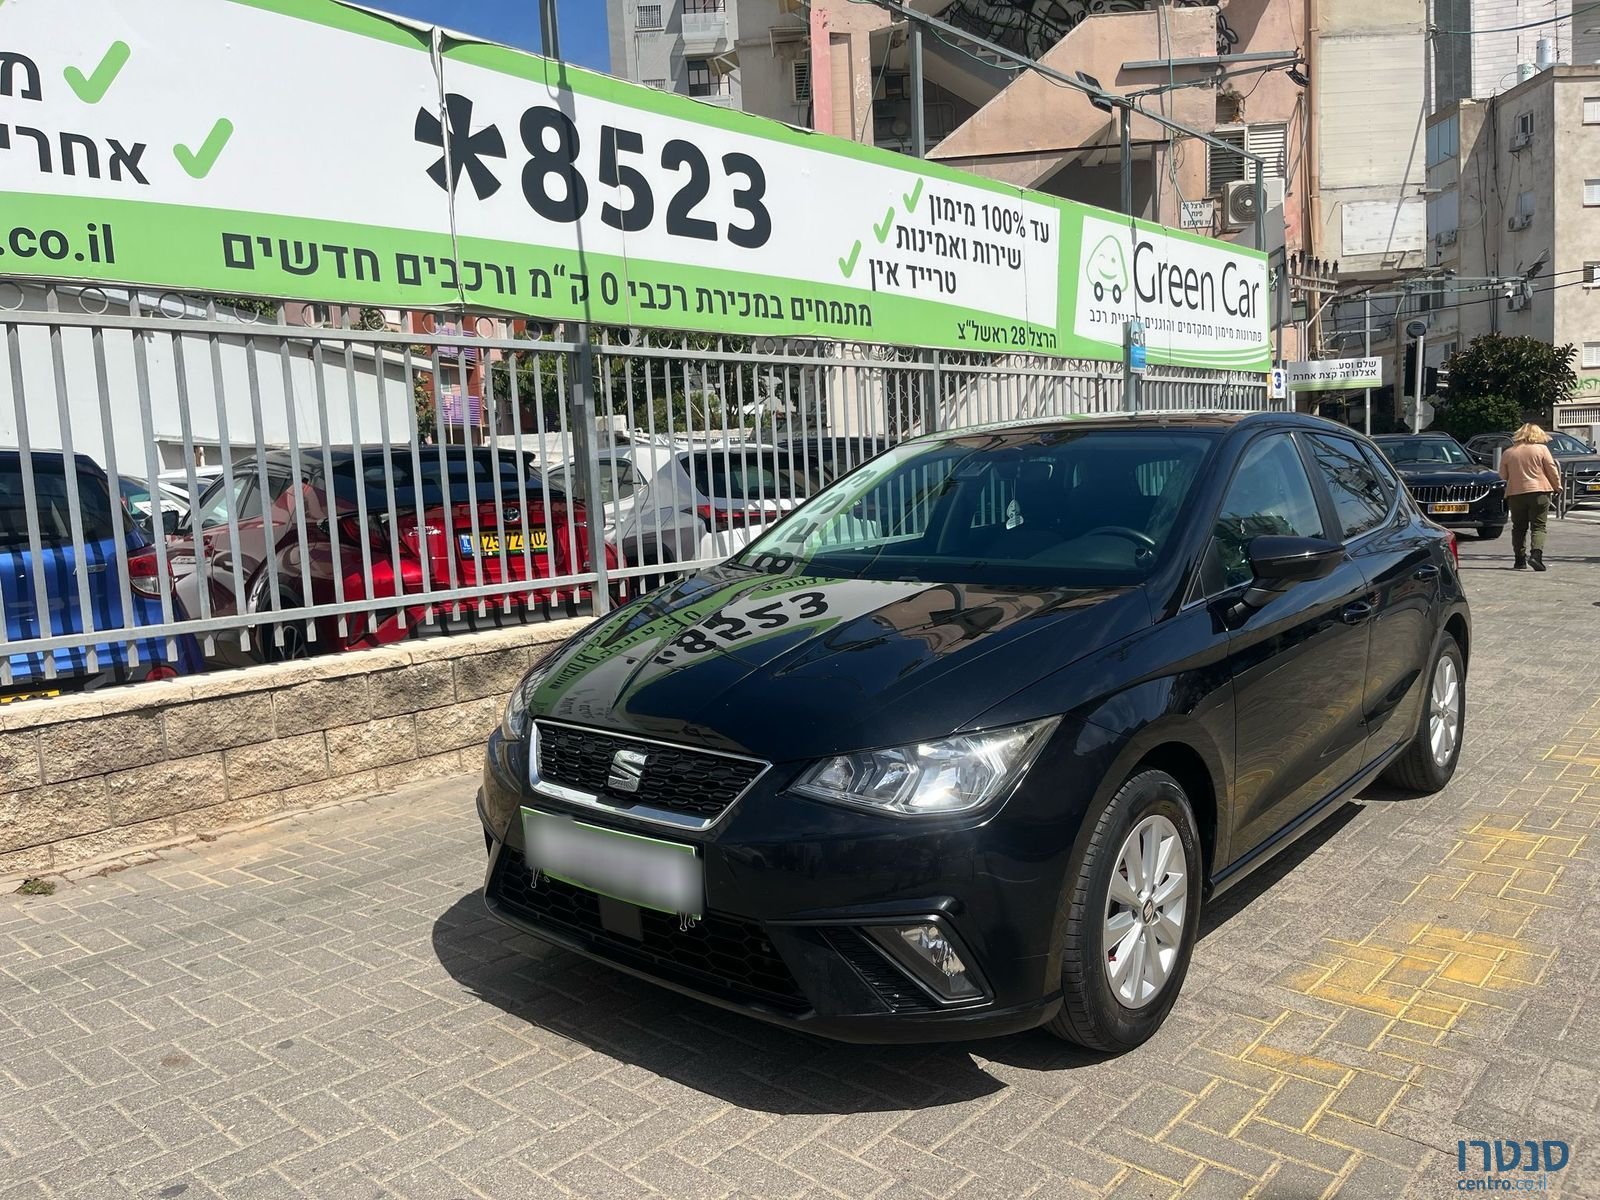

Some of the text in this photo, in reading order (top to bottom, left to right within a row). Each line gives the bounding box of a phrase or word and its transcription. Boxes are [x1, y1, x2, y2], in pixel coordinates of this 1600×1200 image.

[928, 194, 1050, 244] עד 100% מימון
[221, 232, 382, 283] חדשים
[896, 224, 1022, 270] שירות ואמינות
[395, 251, 517, 296] ורכבים
[869, 258, 958, 295] טרייד אין
[1133, 241, 1260, 319] Green Car
[626, 280, 688, 312] רכבי
[696, 286, 784, 320] במכירת
[791, 297, 872, 327] מתמחים
[1089, 309, 1108, 323] רכב
[1145, 317, 1175, 332] והוגנים
[1010, 325, 1026, 347] 28
[1028, 326, 1057, 349] הרצל
[1177, 320, 1213, 338] מתקדמים
[1215, 328, 1234, 341] מימון
[1236, 328, 1262, 343] פתרונות
[1292, 369, 1377, 381] אצלנו זה קצת אחרת
[1356, 360, 1377, 369] שלם
